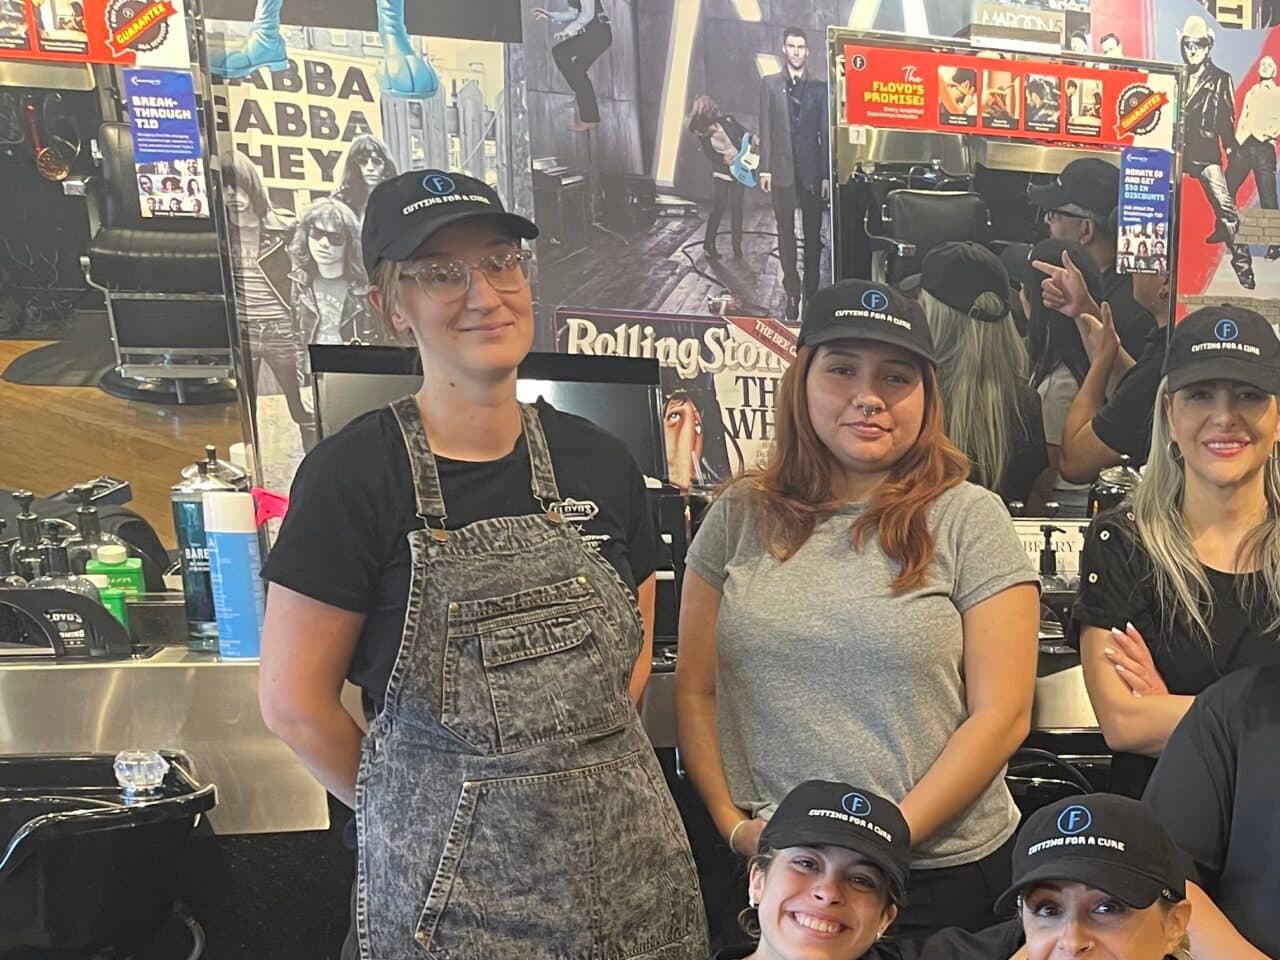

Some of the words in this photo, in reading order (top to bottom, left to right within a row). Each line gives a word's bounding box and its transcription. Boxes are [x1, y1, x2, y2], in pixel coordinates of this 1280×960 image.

[116, 3, 166, 44] GUARANTEE
[211, 58, 375, 103] ABBA
[902, 65, 925, 83] The
[872, 81, 925, 94] FLOYD'S
[132, 95, 179, 108] BREAK-
[133, 107, 193, 120] THROUGH
[135, 118, 160, 130] T1D
[236, 143, 344, 183] HEY
[403, 196, 443, 215] CUTTING
[443, 194, 462, 202] FOR
[1124, 191, 1165, 201] DISCOUNTS
[835, 309, 870, 317] CUTTING
[870, 311, 887, 320] FOR
[754, 319, 776, 341] THE
[771, 331, 793, 353] BEE
[566, 317, 700, 380] Rolling
[700, 327, 792, 375] Ston
[1191, 341, 1221, 353] CUTTING
[1222, 342, 1237, 350] FOR
[735, 374, 782, 408] TH
[725, 407, 780, 441] WH
[1023, 541, 1073, 553] BERY
[808, 809, 849, 821] CUTTING
[849, 816, 867, 828] FOR
[1028, 837, 1064, 855] CUTTING
[1065, 836, 1086, 845] FOR
[1097, 837, 1126, 851] CURE
